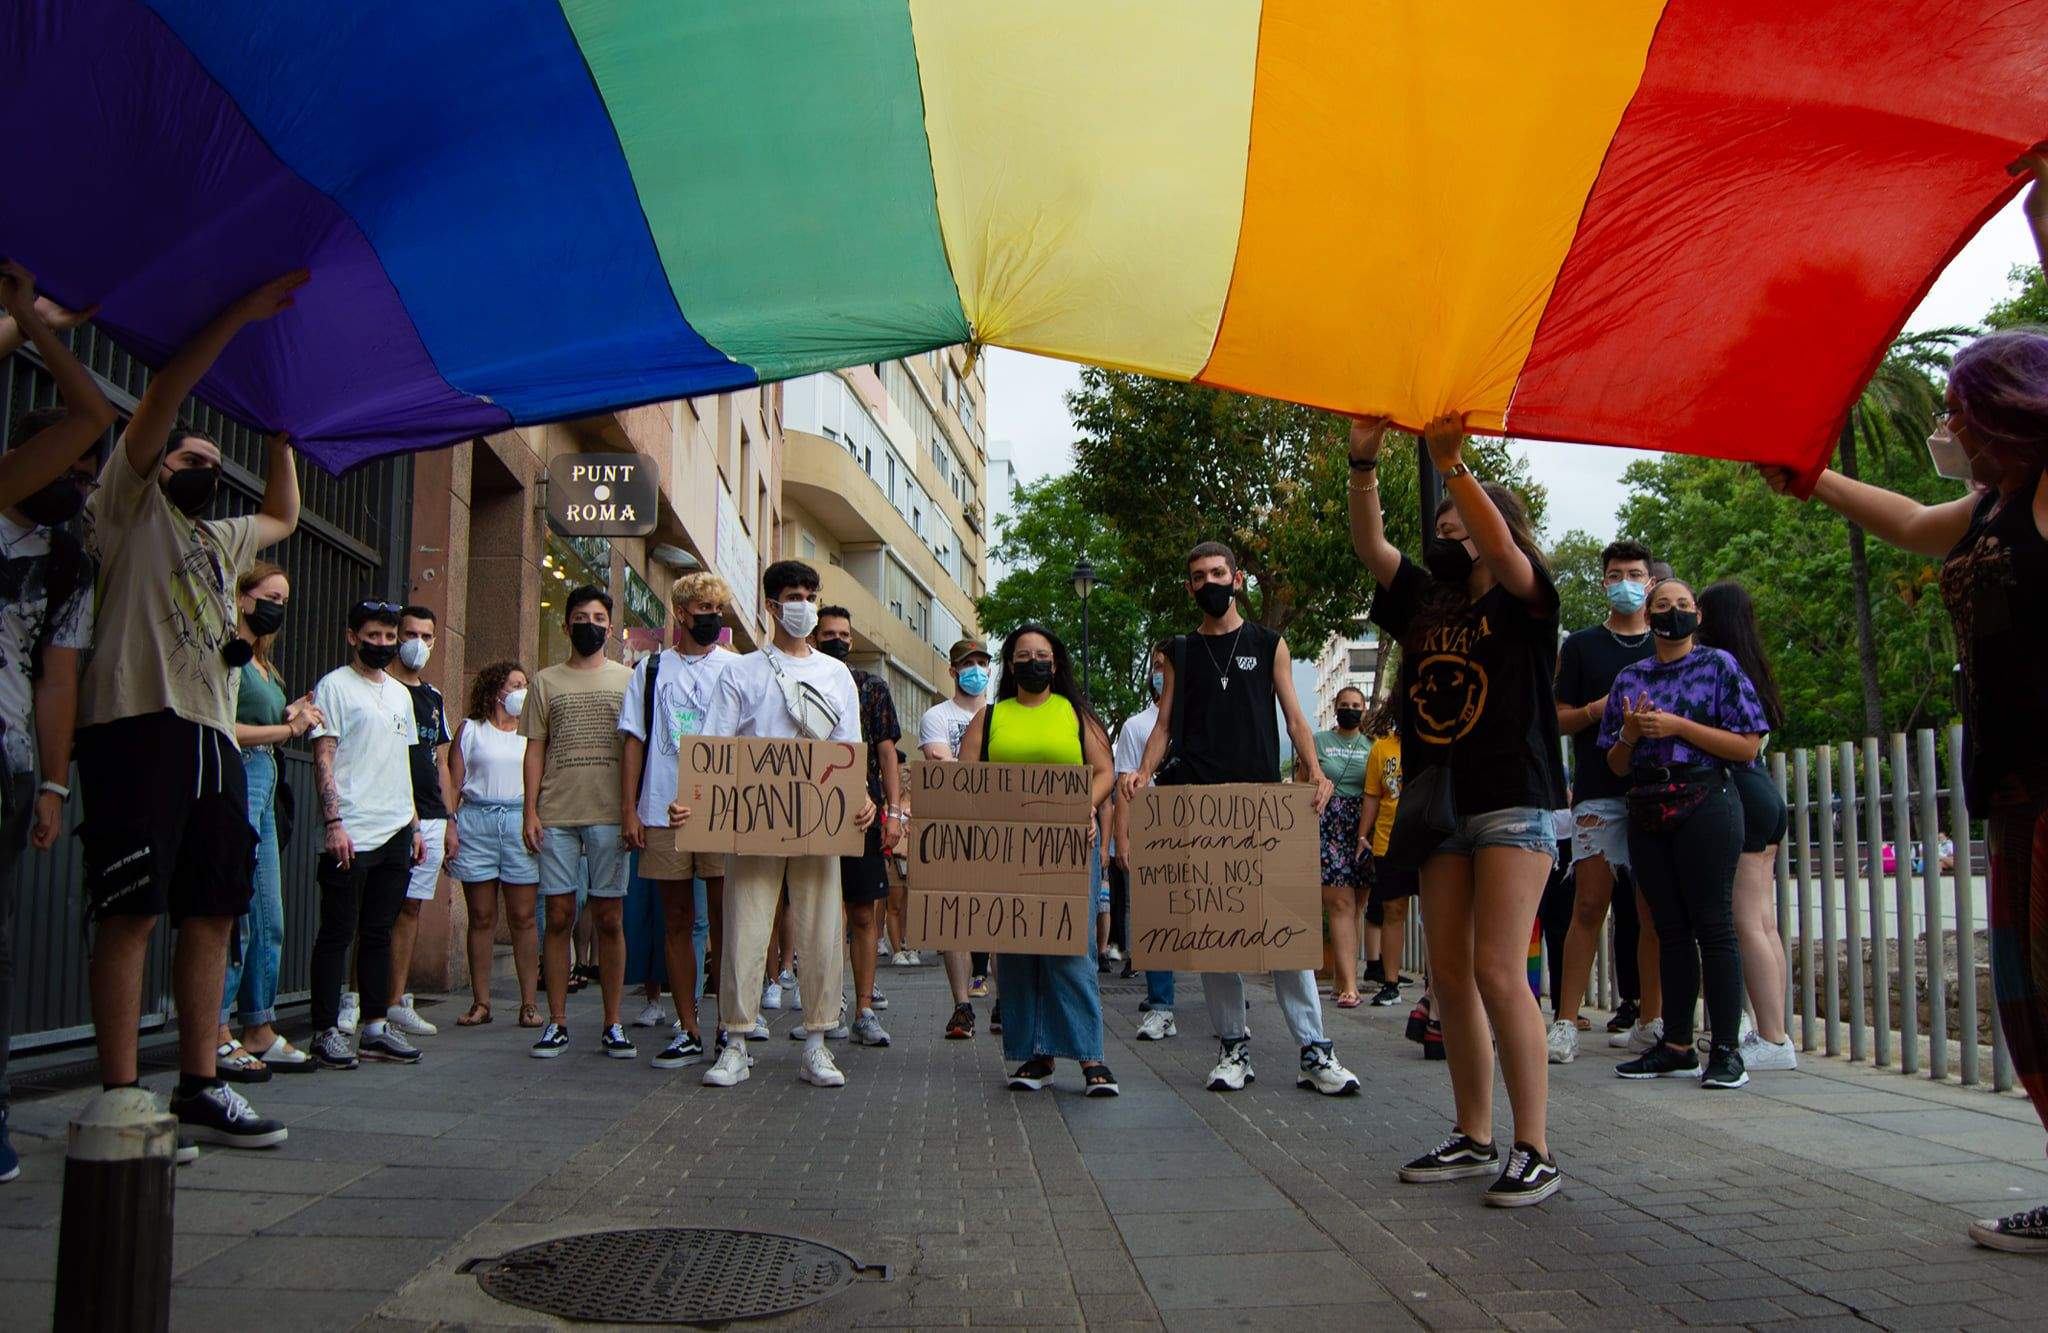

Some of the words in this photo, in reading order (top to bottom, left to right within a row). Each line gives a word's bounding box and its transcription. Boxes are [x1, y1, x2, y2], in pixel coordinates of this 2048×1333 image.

[572, 464, 635, 482] PUNT
[566, 503, 637, 522] ROMA
[691, 742, 735, 775] QUE
[922, 766, 945, 790] LO
[952, 767, 990, 794] QUE
[997, 768, 1012, 793] TE
[1021, 769, 1089, 796] LLAMAN
[708, 780, 845, 842] PASANDO
[1144, 793, 1162, 831] SI
[920, 822, 999, 864] CUANDO
[1002, 827, 1014, 864] TE
[1022, 826, 1088, 868] MATAN
[1145, 829, 1281, 851] mirando
[1224, 859, 1263, 886] NOS
[1139, 919, 1307, 954] matando
